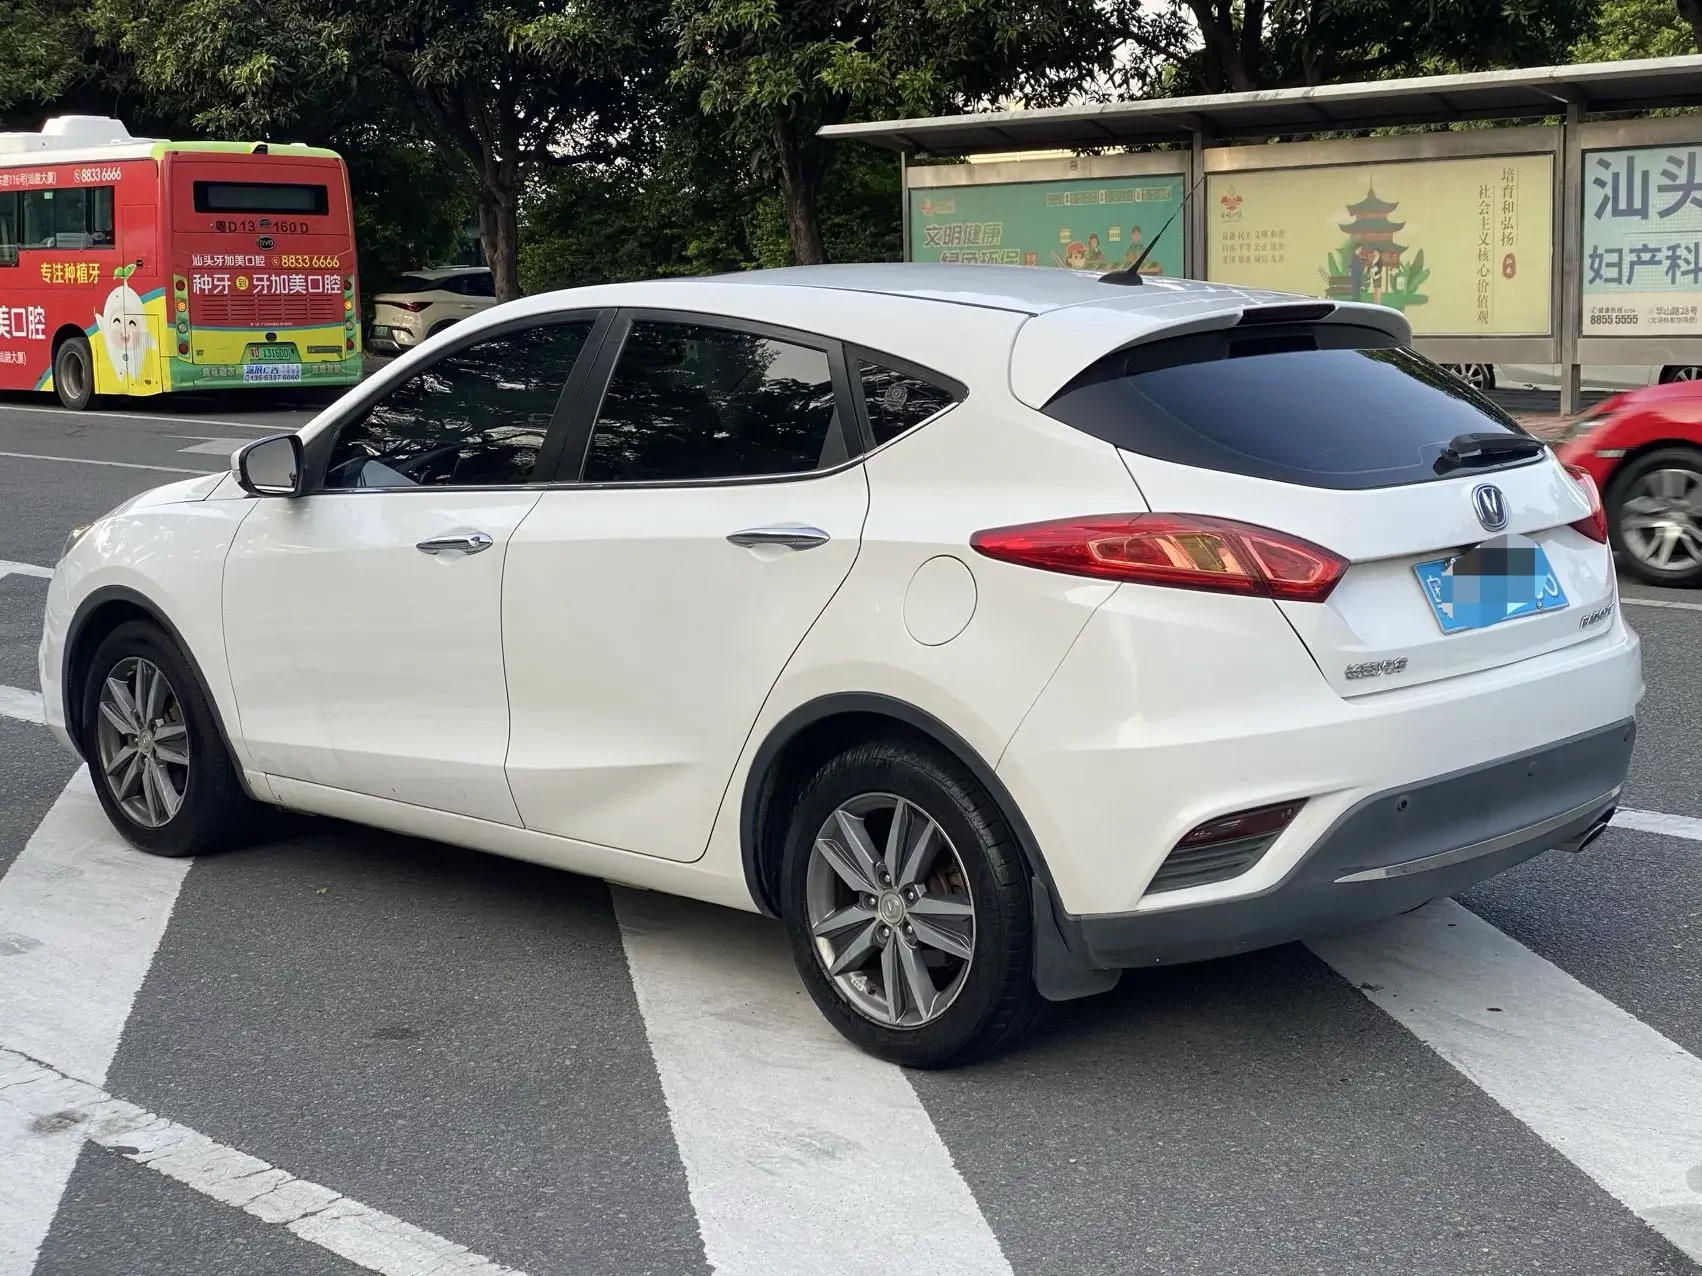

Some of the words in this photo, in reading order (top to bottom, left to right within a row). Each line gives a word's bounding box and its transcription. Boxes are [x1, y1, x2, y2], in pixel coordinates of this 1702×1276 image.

[81, 168, 100, 182] 8833
[102, 167, 121, 181] 6666
[1592, 151, 1702, 220] 汕头
[1501, 168, 1515, 246] 培育和弘扬
[924, 222, 1003, 248] 文明健康
[192, 254, 265, 267] 汕头牙加美口腔
[281, 255, 310, 268] 8833
[312, 255, 340, 268] 6666
[1476, 184, 1491, 325] 社会主义核心价值观
[1588, 241, 1702, 286] 妇产科
[40, 262, 100, 284] 专注种植牙
[193, 273, 231, 295] 种牙
[253, 273, 342, 295] 牙加美口腔
[0, 305, 46, 340] 美口腔
[1590, 314, 1613, 325] 8855
[1615, 314, 1639, 325] 5555
